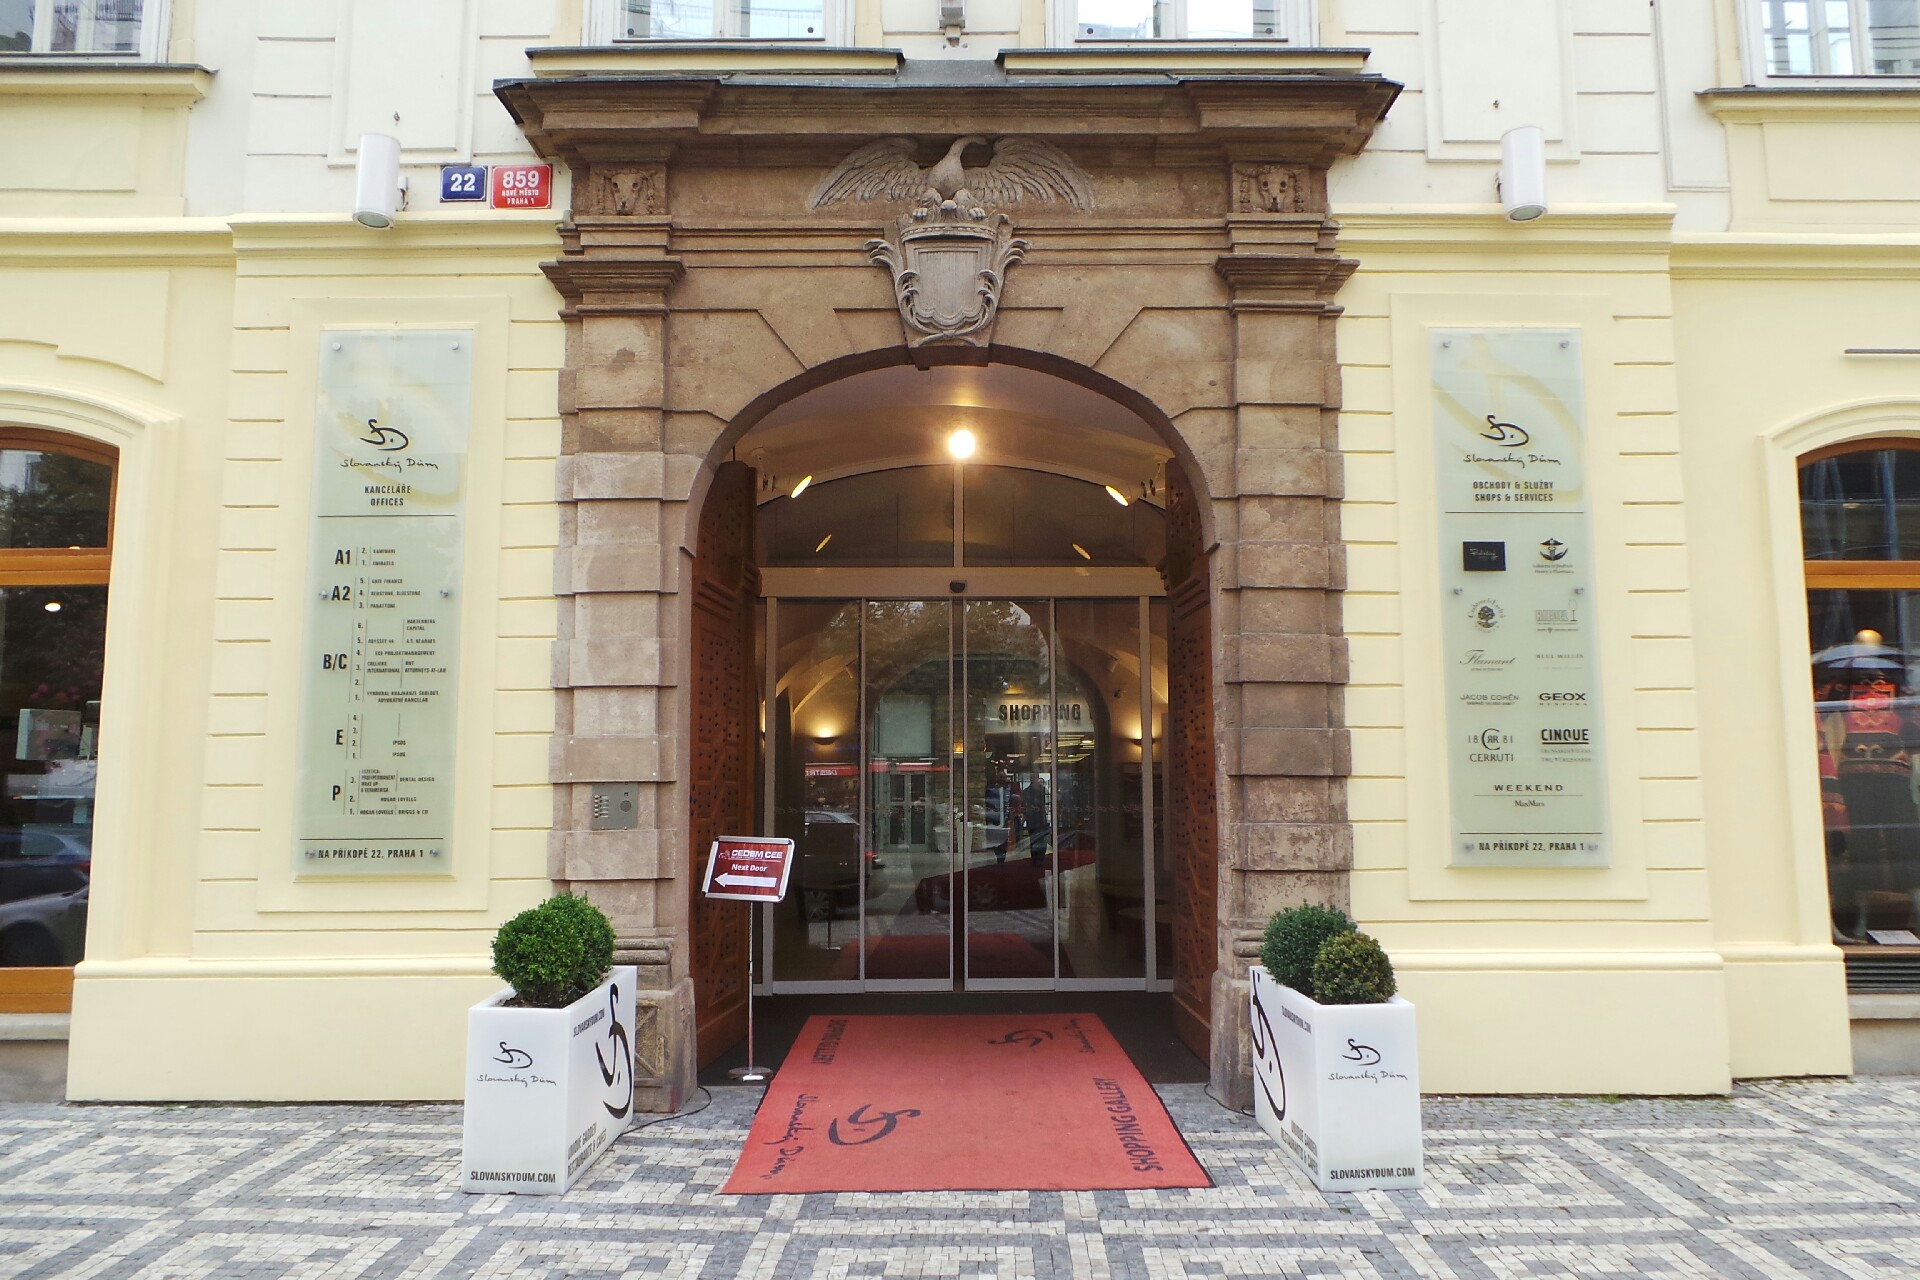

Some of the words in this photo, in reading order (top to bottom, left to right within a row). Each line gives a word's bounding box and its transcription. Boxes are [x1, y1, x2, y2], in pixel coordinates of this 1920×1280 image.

[450, 173, 476, 192] 22
[502, 170, 540, 188] 859
[502, 188, 516, 196] NOVÉ
[519, 188, 539, 196] MĚSTO
[364, 484, 411, 494] KANCELÁŘE
[1524, 480, 1554, 489] SLUŽBY
[370, 498, 404, 506] OFFICES
[335, 550, 350, 564] A1
[332, 586, 350, 600] A2
[323, 654, 348, 670] B/C
[1460, 650, 1516, 665] Flamant
[1538, 692, 1586, 700] GEOX
[336, 729, 344, 745] E
[1541, 728, 1589, 741] CINQUE
[1470, 754, 1514, 762] CERRUTI
[332, 785, 340, 800] P
[1479, 842, 1490, 850] NA
[1494, 840, 1529, 850] PŘÍKOPĚ
[1533, 843, 1546, 852] 22,
[1550, 842, 1576, 850] PRAHA
[1580, 842, 1584, 850] 1
[318, 850, 330, 858] NA
[332, 848, 368, 858] PŘÍKOPĚ
[371, 850, 384, 859] 22,
[388, 850, 416, 858] PRAHA
[420, 850, 424, 858] 1
[1093, 1078, 1132, 1114] GALLERY
[1110, 1115, 1163, 1172] SHOPPING
[470, 1170, 556, 1183] SLOVANSKYDUM.COM
[1330, 1168, 1415, 1180] SLOVANSKYDUM.COM
